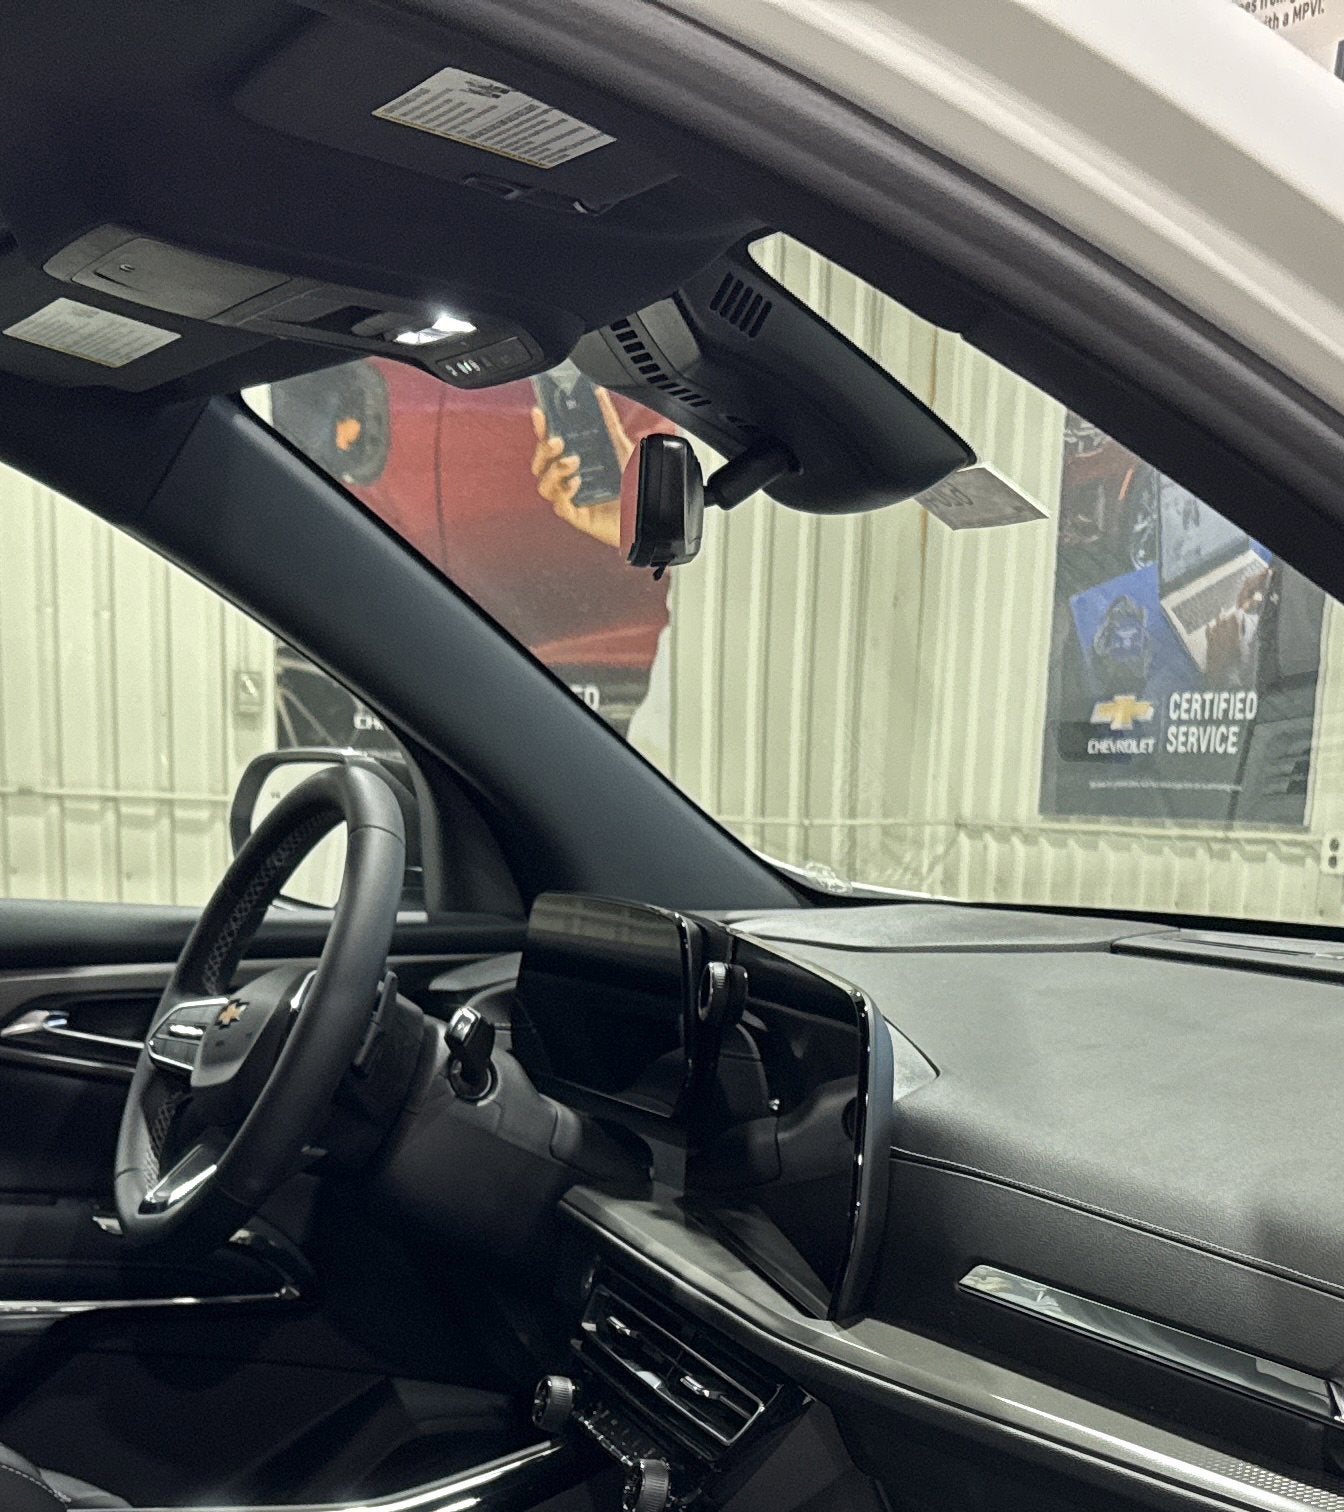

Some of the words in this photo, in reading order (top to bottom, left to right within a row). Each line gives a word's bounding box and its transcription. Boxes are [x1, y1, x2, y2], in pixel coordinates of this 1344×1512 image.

[1282, 12, 1289, 27] a
[1168, 690, 1258, 721] CERTIFIED
[1087, 737, 1155, 754] CHEVROLET
[1166, 724, 1240, 754] SERVICE
